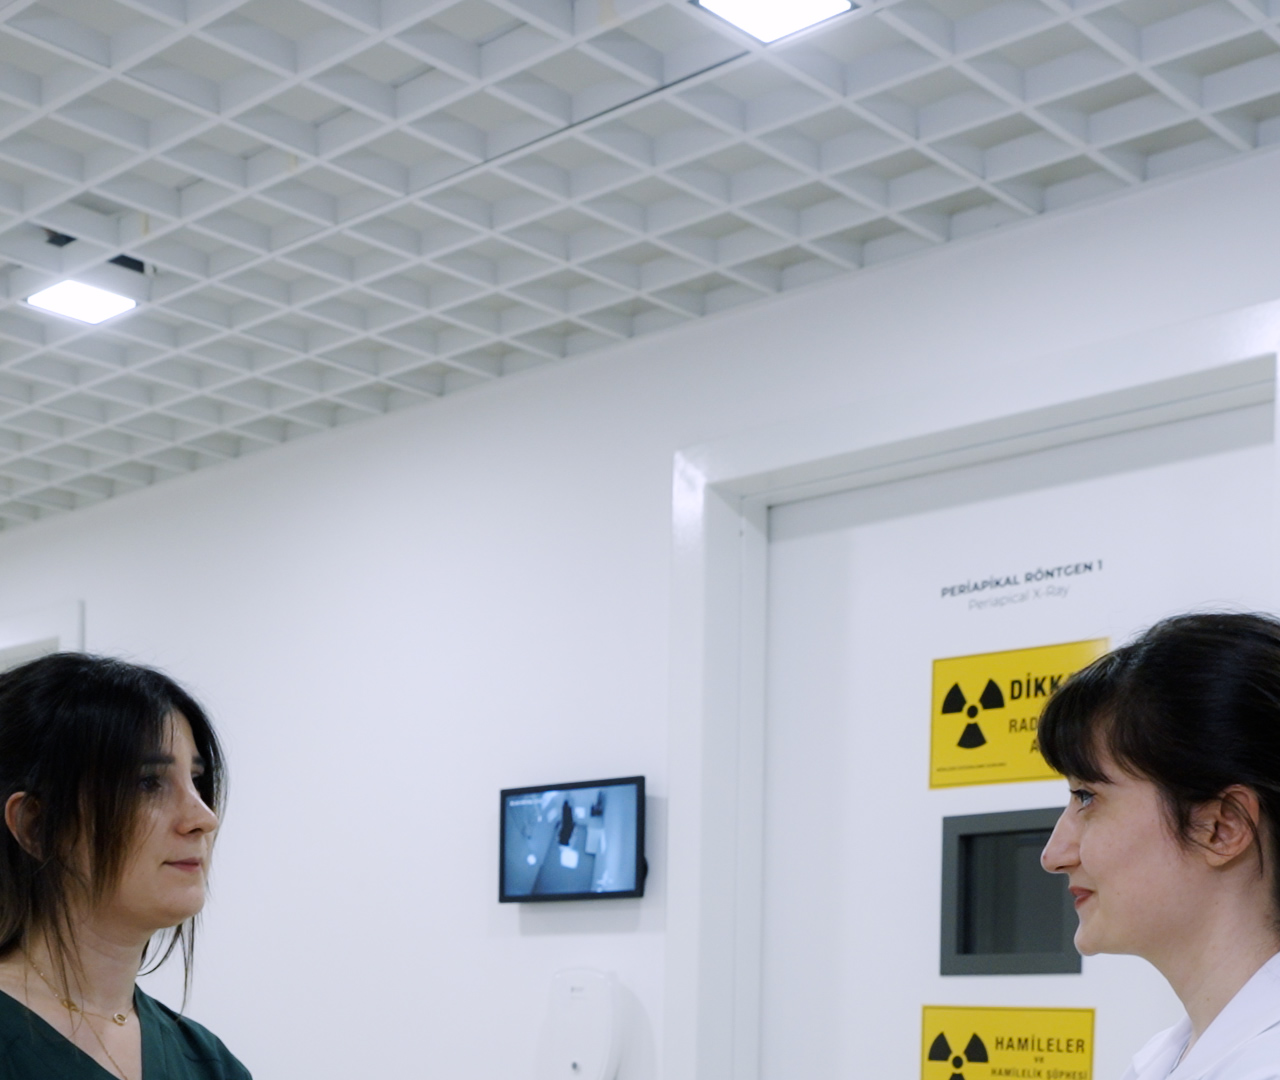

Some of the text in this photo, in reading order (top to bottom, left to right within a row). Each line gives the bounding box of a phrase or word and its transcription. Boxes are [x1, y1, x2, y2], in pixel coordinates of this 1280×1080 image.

[941, 575, 1019, 598] PERİAPİKAL
[1025, 562, 1093, 583] RÖNTGEN
[1010, 672, 1063, 700] DİKK
[995, 1035, 1085, 1054] HAMİLELER
